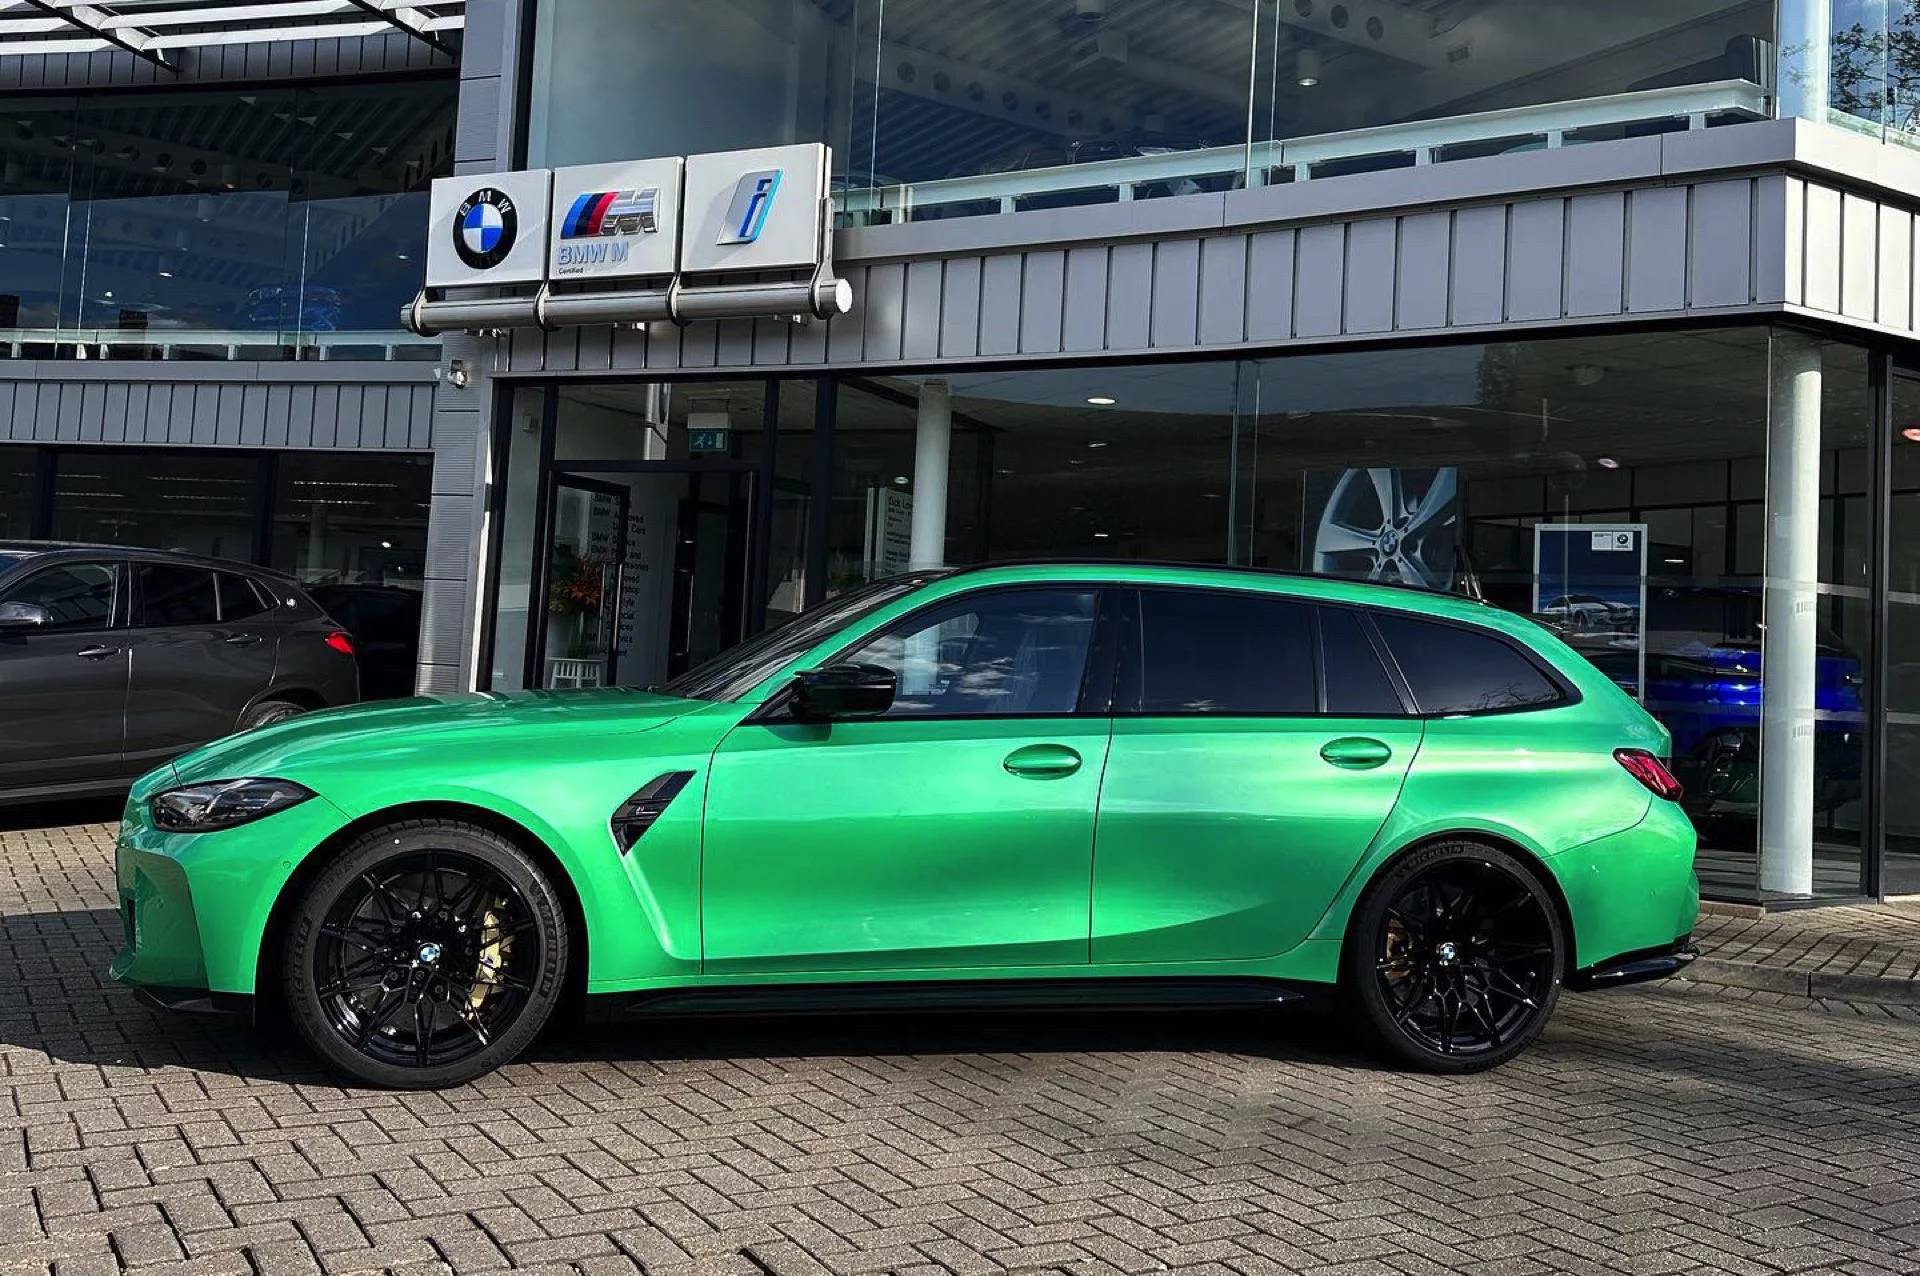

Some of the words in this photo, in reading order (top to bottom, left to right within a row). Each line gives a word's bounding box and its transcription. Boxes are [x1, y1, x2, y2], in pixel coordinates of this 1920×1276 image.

[460, 191, 512, 217] BMW
[558, 243, 608, 265] BMW
[612, 240, 629, 262] M
[540, 902, 558, 997] MICHELIN
